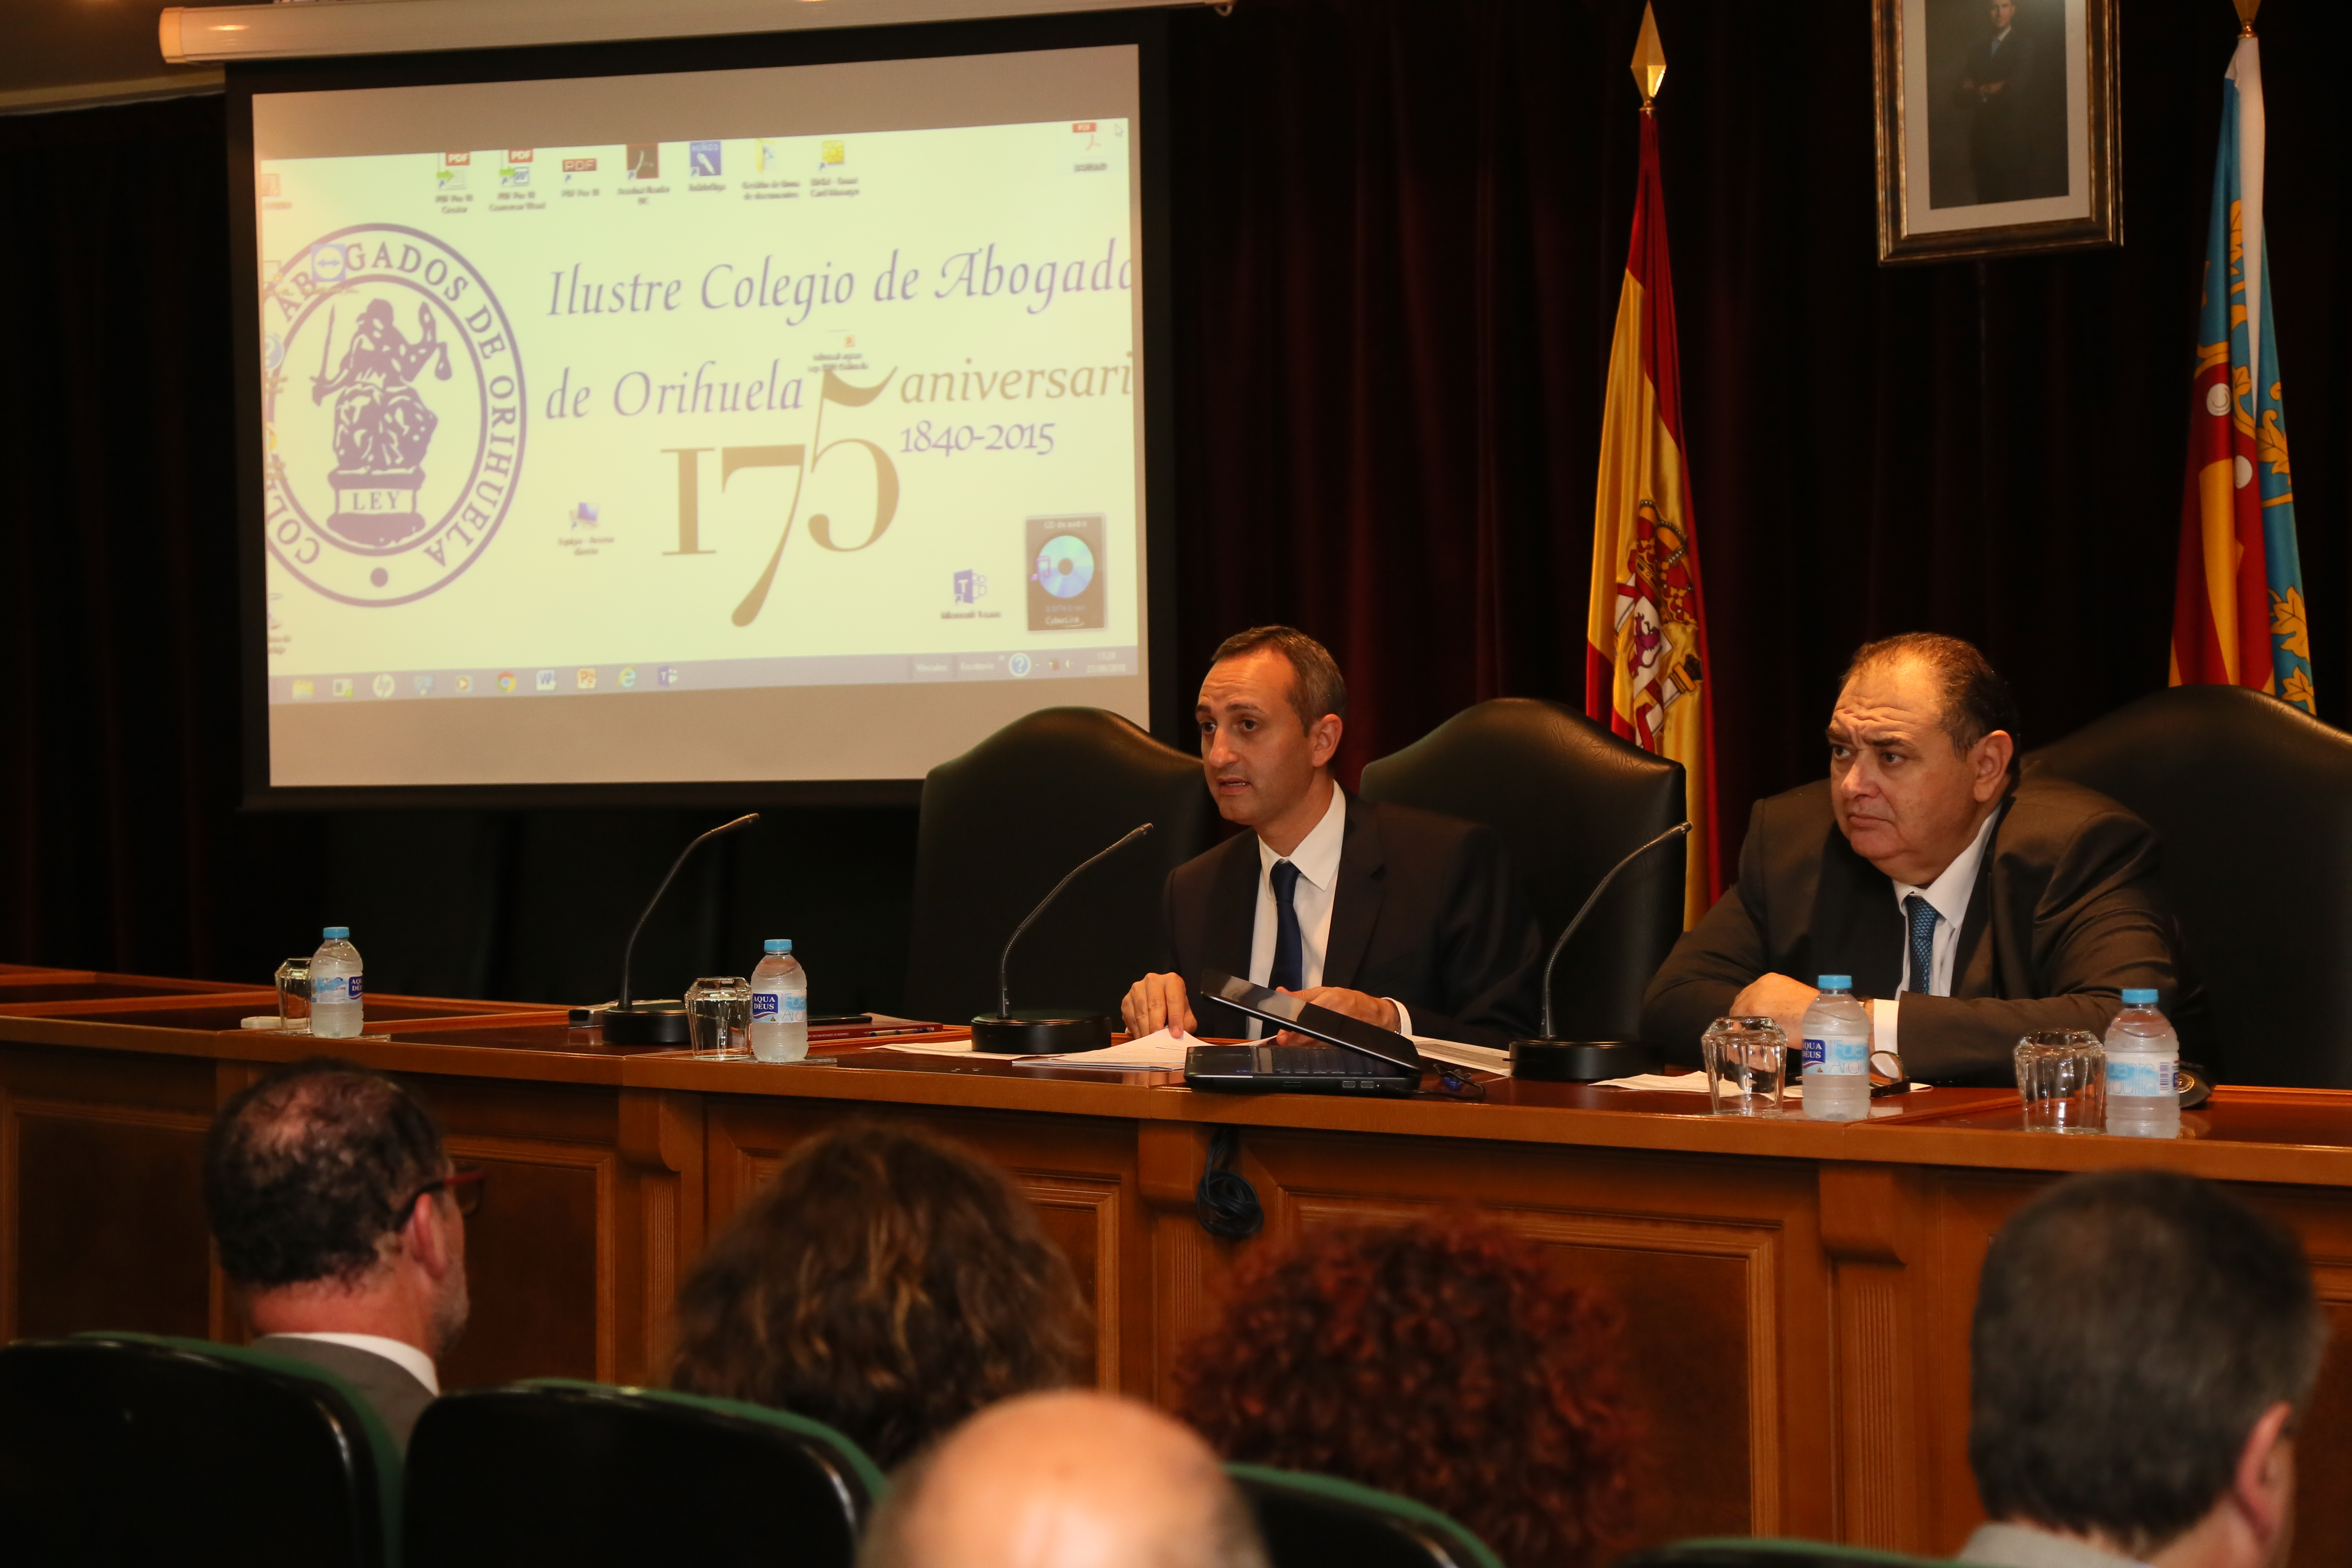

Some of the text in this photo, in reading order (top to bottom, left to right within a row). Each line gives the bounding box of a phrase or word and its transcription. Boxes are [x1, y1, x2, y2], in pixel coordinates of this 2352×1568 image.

[564, 160, 595, 171] PDF
[278, 242, 468, 322] ABGADOS
[546, 262, 682, 316] Ilustre
[700, 254, 855, 327] Colegio
[873, 248, 920, 302] de
[465, 305, 507, 359] DE
[545, 366, 591, 420] de
[612, 358, 803, 416] Orihuela
[900, 419, 1056, 457] 1840-2015
[352, 490, 401, 510] LEY
[423, 374, 516, 567] ORIHUELA
[660, 366, 900, 627] 175
